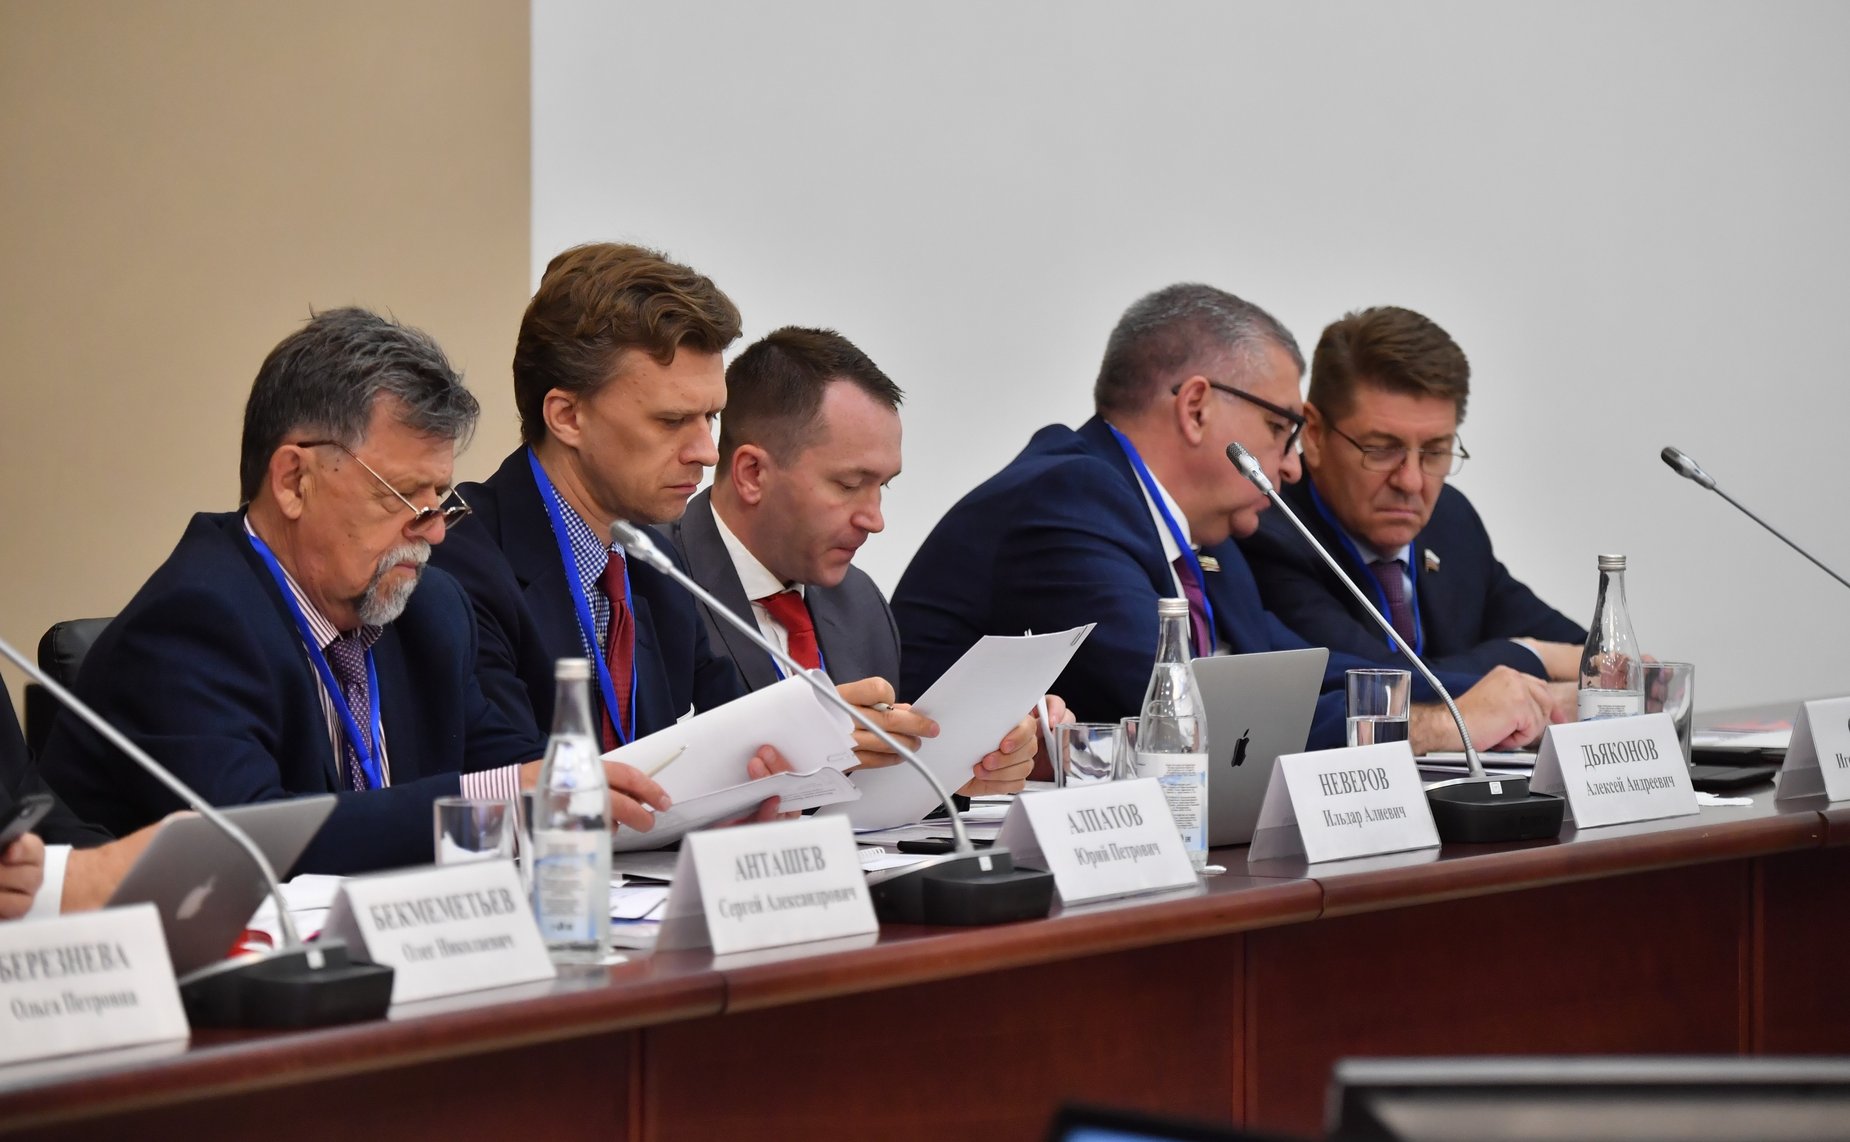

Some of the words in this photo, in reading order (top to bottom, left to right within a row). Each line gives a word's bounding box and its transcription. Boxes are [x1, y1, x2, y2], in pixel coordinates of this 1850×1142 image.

[1581, 738, 1659, 772] ДЬЯКОНОВ
[1318, 767, 1390, 796] НЕВЕРОВ
[1586, 777, 1626, 797] Алексей
[1626, 775, 1676, 795] Андреевич
[1067, 803, 1144, 835] АЛПАТОВ
[1322, 809, 1363, 828] Ильдар
[1364, 805, 1407, 823] Алиевич
[735, 845, 826, 881] АНТАШЕВ
[1074, 845, 1110, 869] Юрий
[1108, 842, 1162, 863] Петрович
[369, 887, 517, 931] БЕКМЕМЕТЬЕВ
[718, 894, 764, 922] Сергей
[765, 886, 858, 912] Александрович
